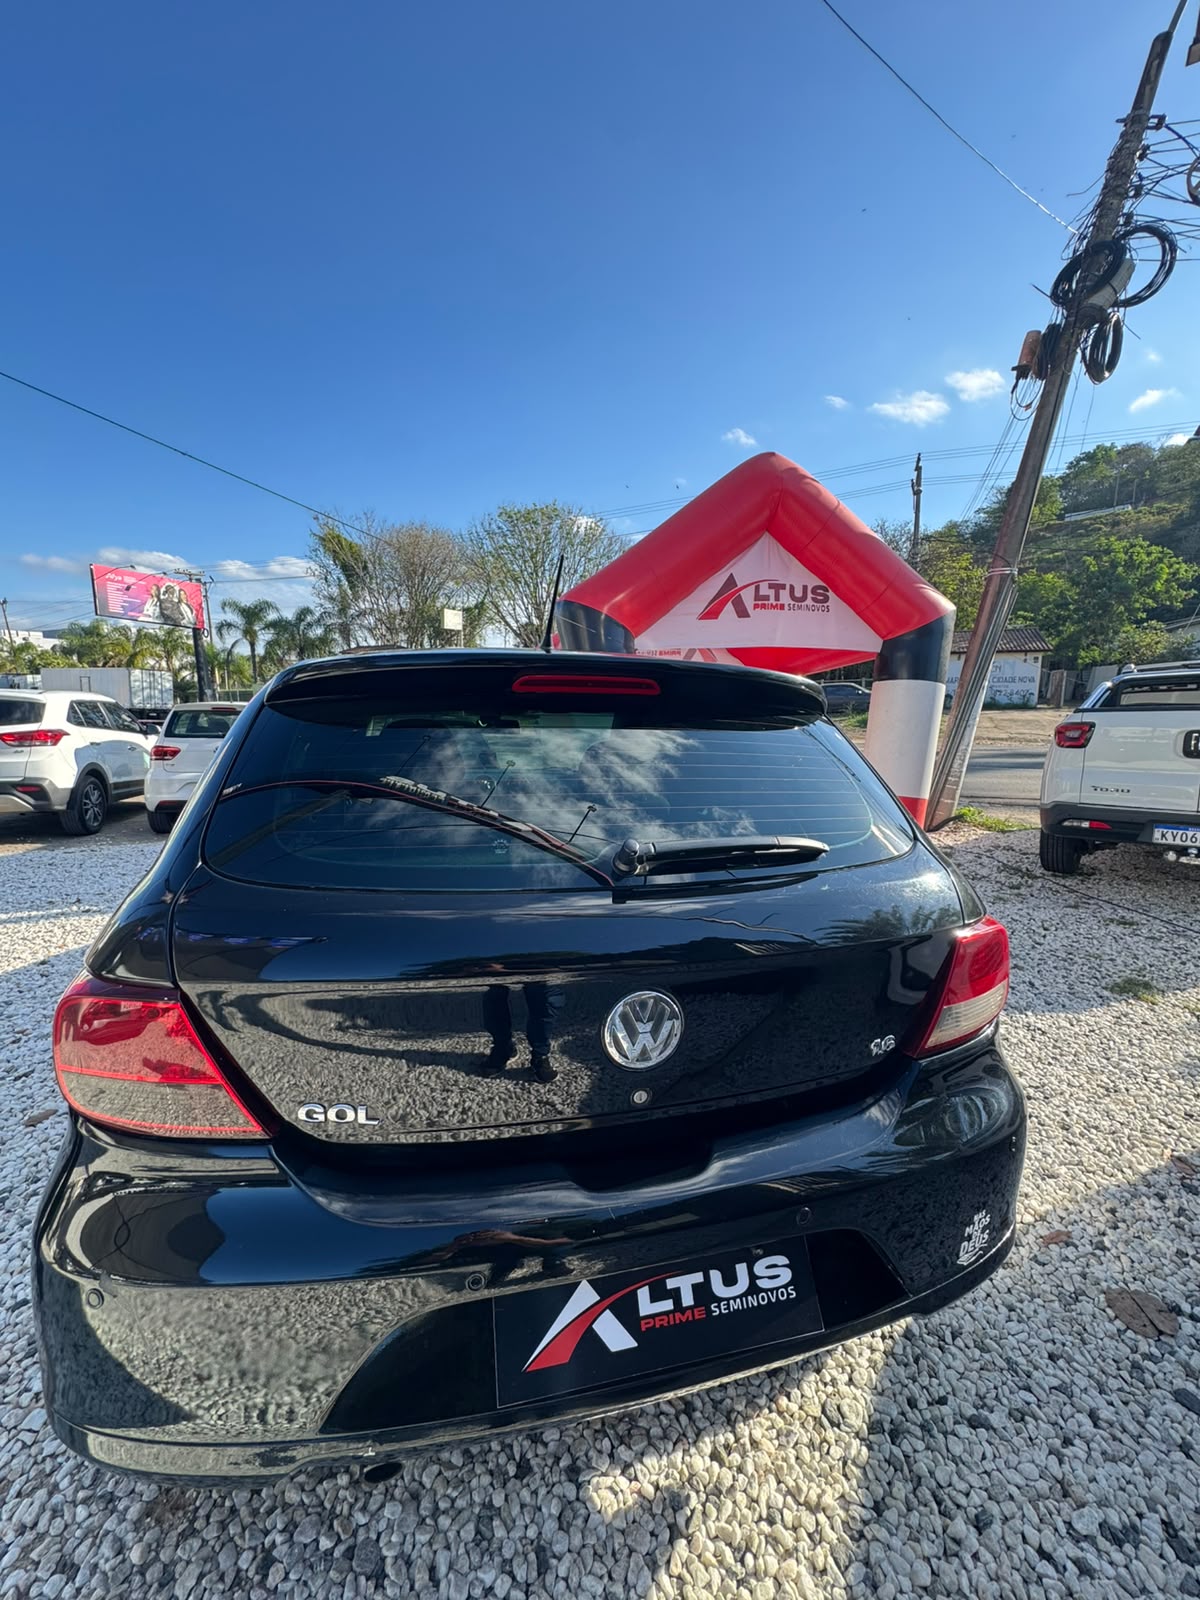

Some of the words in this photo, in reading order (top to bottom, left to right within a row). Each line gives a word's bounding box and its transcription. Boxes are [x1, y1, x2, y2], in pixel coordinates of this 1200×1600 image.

[697, 572, 830, 621] ALTUS
[752, 602, 785, 611] PRIME
[787, 603, 831, 613] SEMINOVOS
[992, 676, 1016, 684] CIDADE
[1017, 676, 1036, 684] NOVA
[298, 1103, 380, 1126] GOL
[959, 1229, 990, 1258] DEUS
[521, 1254, 793, 1373] ALTUS
[640, 1306, 706, 1332] PRIME
[710, 1285, 797, 1317] SEMINOVOS
